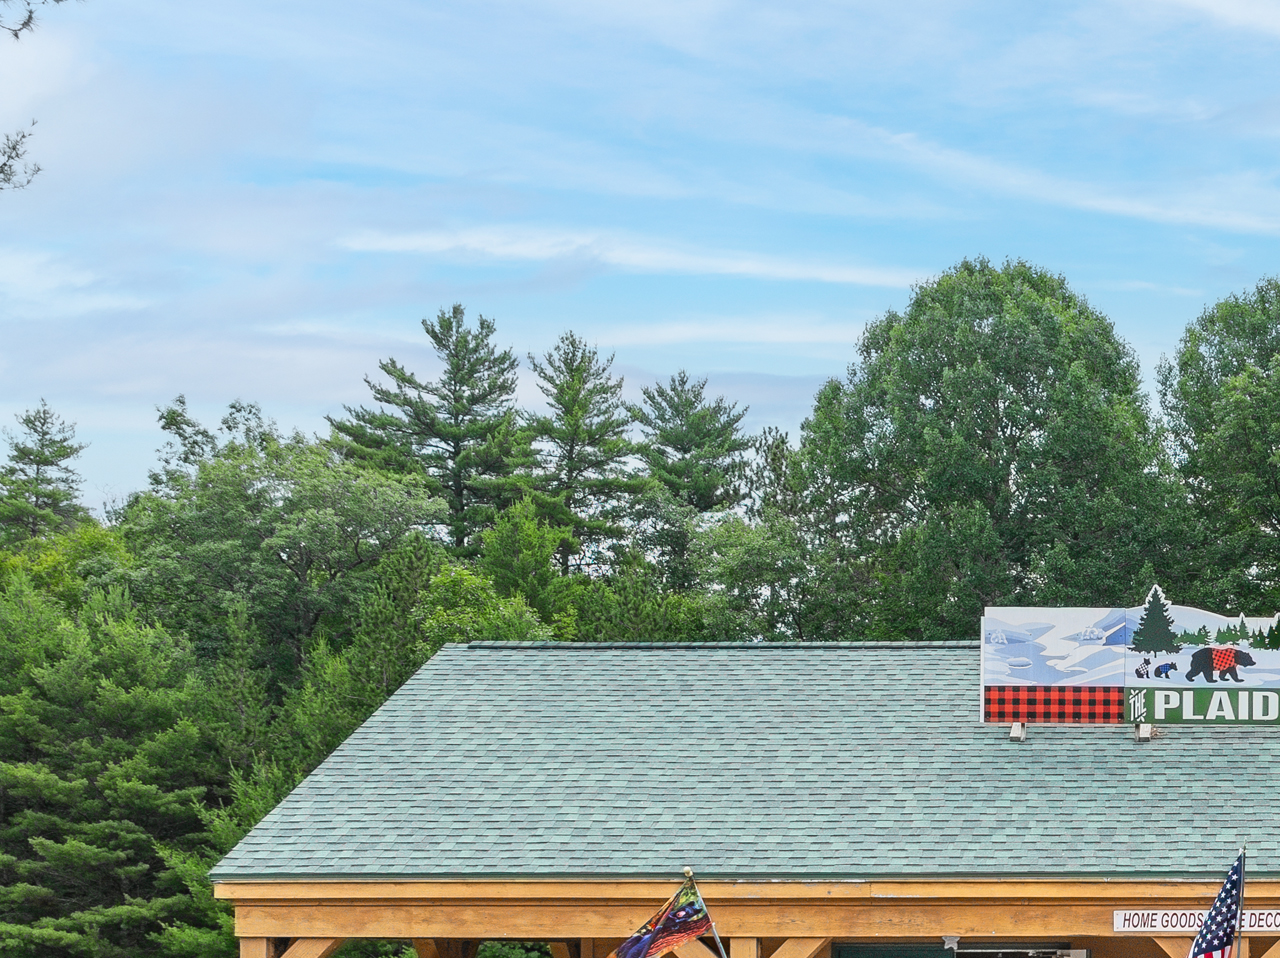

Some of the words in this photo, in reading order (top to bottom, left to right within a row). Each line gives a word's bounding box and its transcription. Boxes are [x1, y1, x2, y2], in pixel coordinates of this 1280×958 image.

[1129, 689, 1147, 722] THE
[1154, 690, 1279, 720] PLAID
[1122, 912, 1158, 929] HOME
[1161, 912, 1204, 929] GOODS
